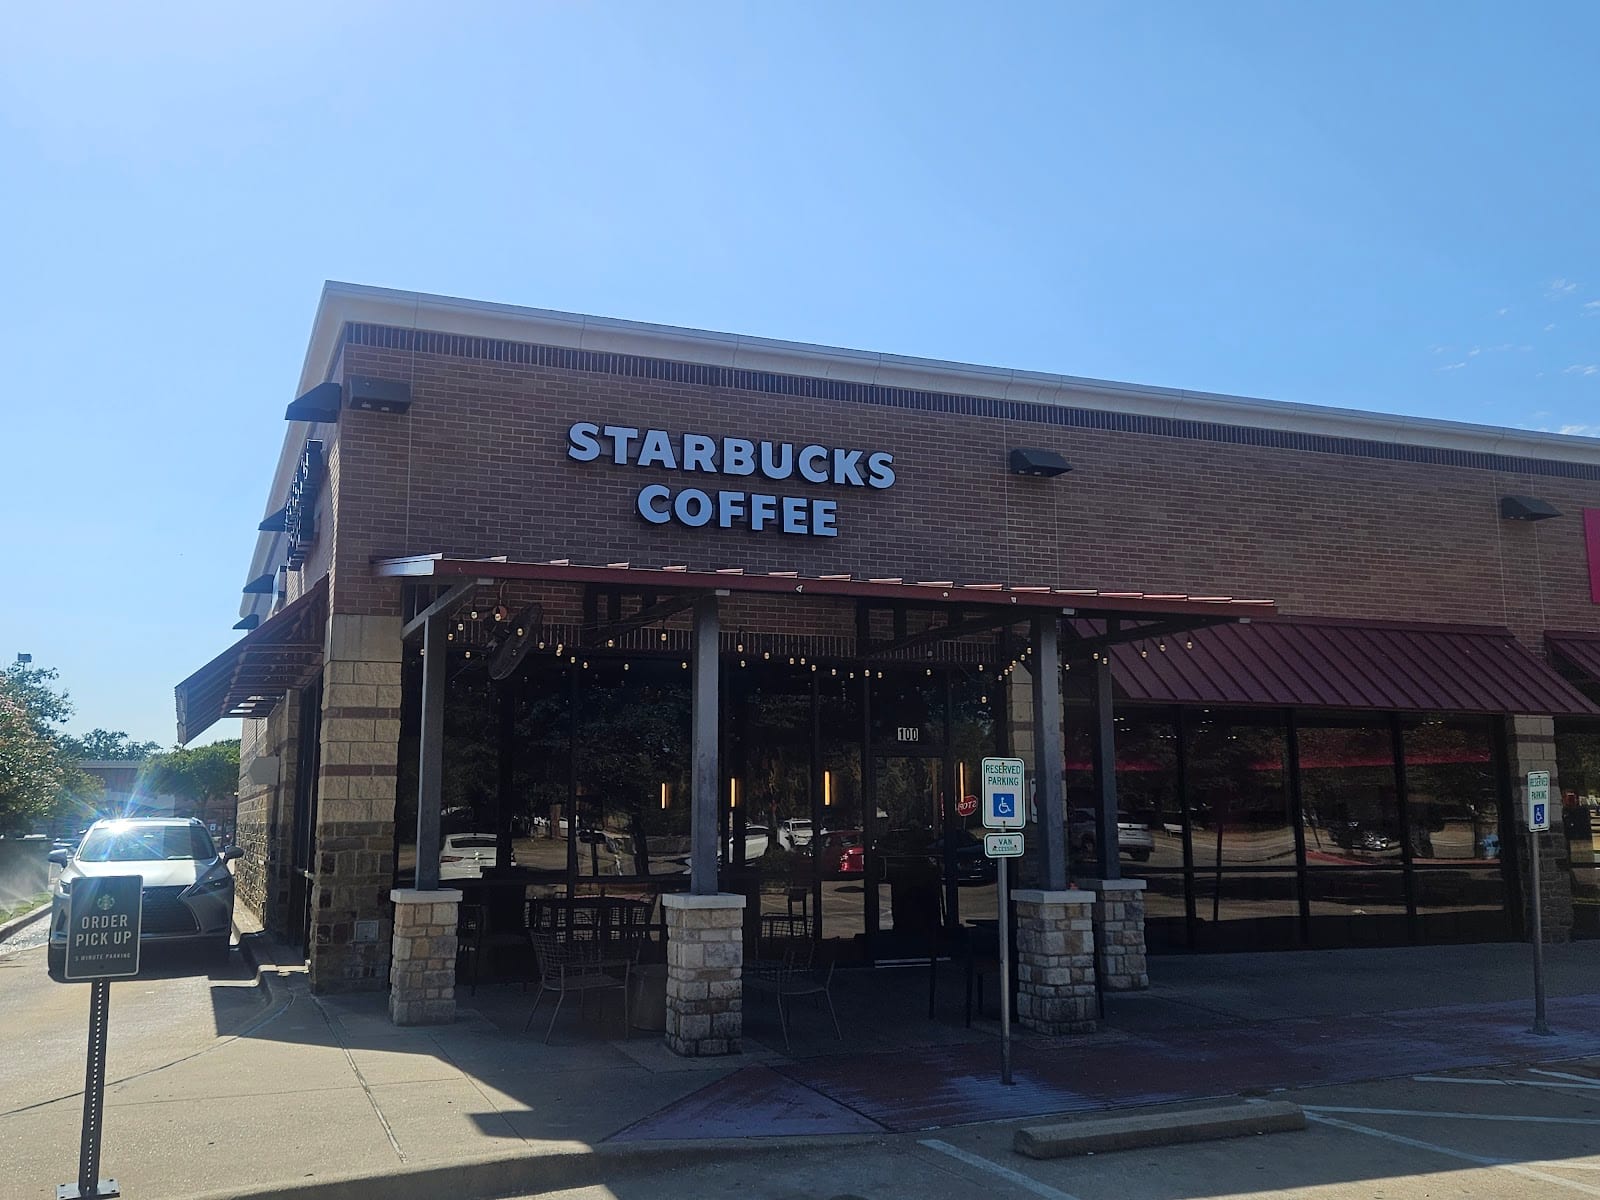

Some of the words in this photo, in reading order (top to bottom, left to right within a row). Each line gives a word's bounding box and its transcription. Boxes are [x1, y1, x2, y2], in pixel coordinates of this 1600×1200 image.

[567, 421, 897, 490] STARBUCKS
[636, 484, 838, 538] COFFEE
[899, 728, 918, 741] 100
[985, 764, 1021, 775] RESERVED
[988, 776, 1019, 786] PARKING
[1530, 776, 1548, 788] RESERVED
[1531, 789, 1547, 800] PARKING
[998, 838, 1013, 846] VAN
[81, 914, 128, 929] ORDER
[75, 931, 108, 947] PICK
[113, 930, 132, 945] UP
[80, 953, 104, 961] MINUTE
[105, 952, 132, 960] PARKING
